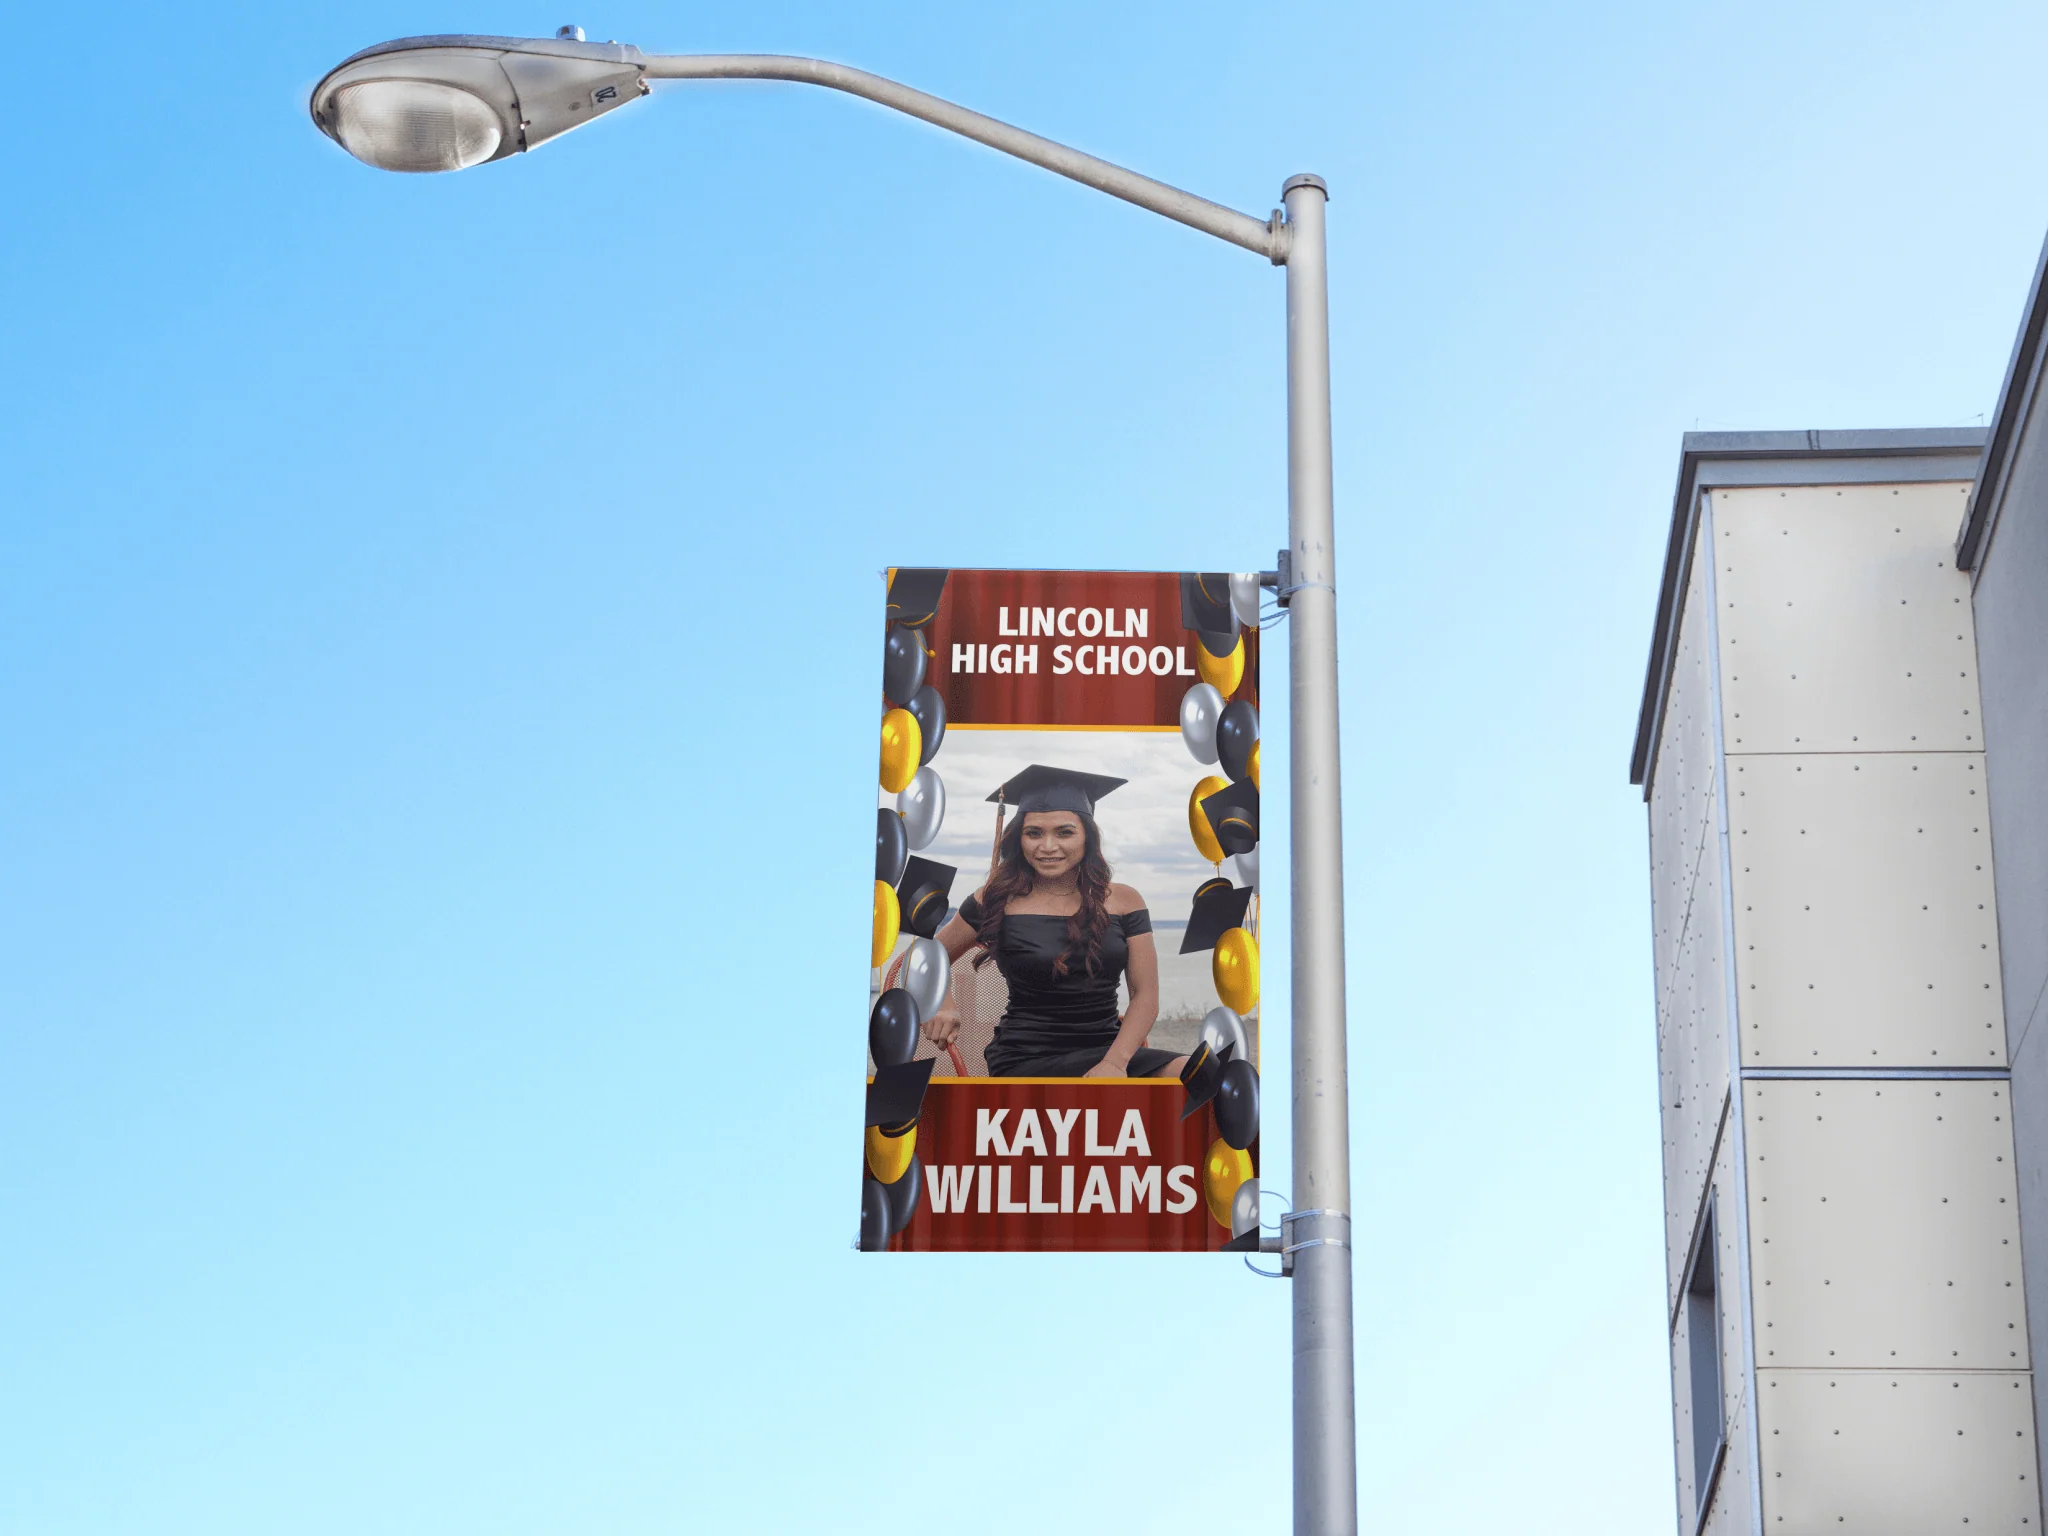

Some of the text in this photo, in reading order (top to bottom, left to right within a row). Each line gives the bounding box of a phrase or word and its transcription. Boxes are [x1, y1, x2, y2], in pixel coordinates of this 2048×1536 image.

[998, 606, 1149, 638] LINCOLN
[951, 643, 1196, 676] HIGH SCHOOL
[975, 1108, 1152, 1157] KAYLA
[924, 1164, 1198, 1214] WILLIAMS
